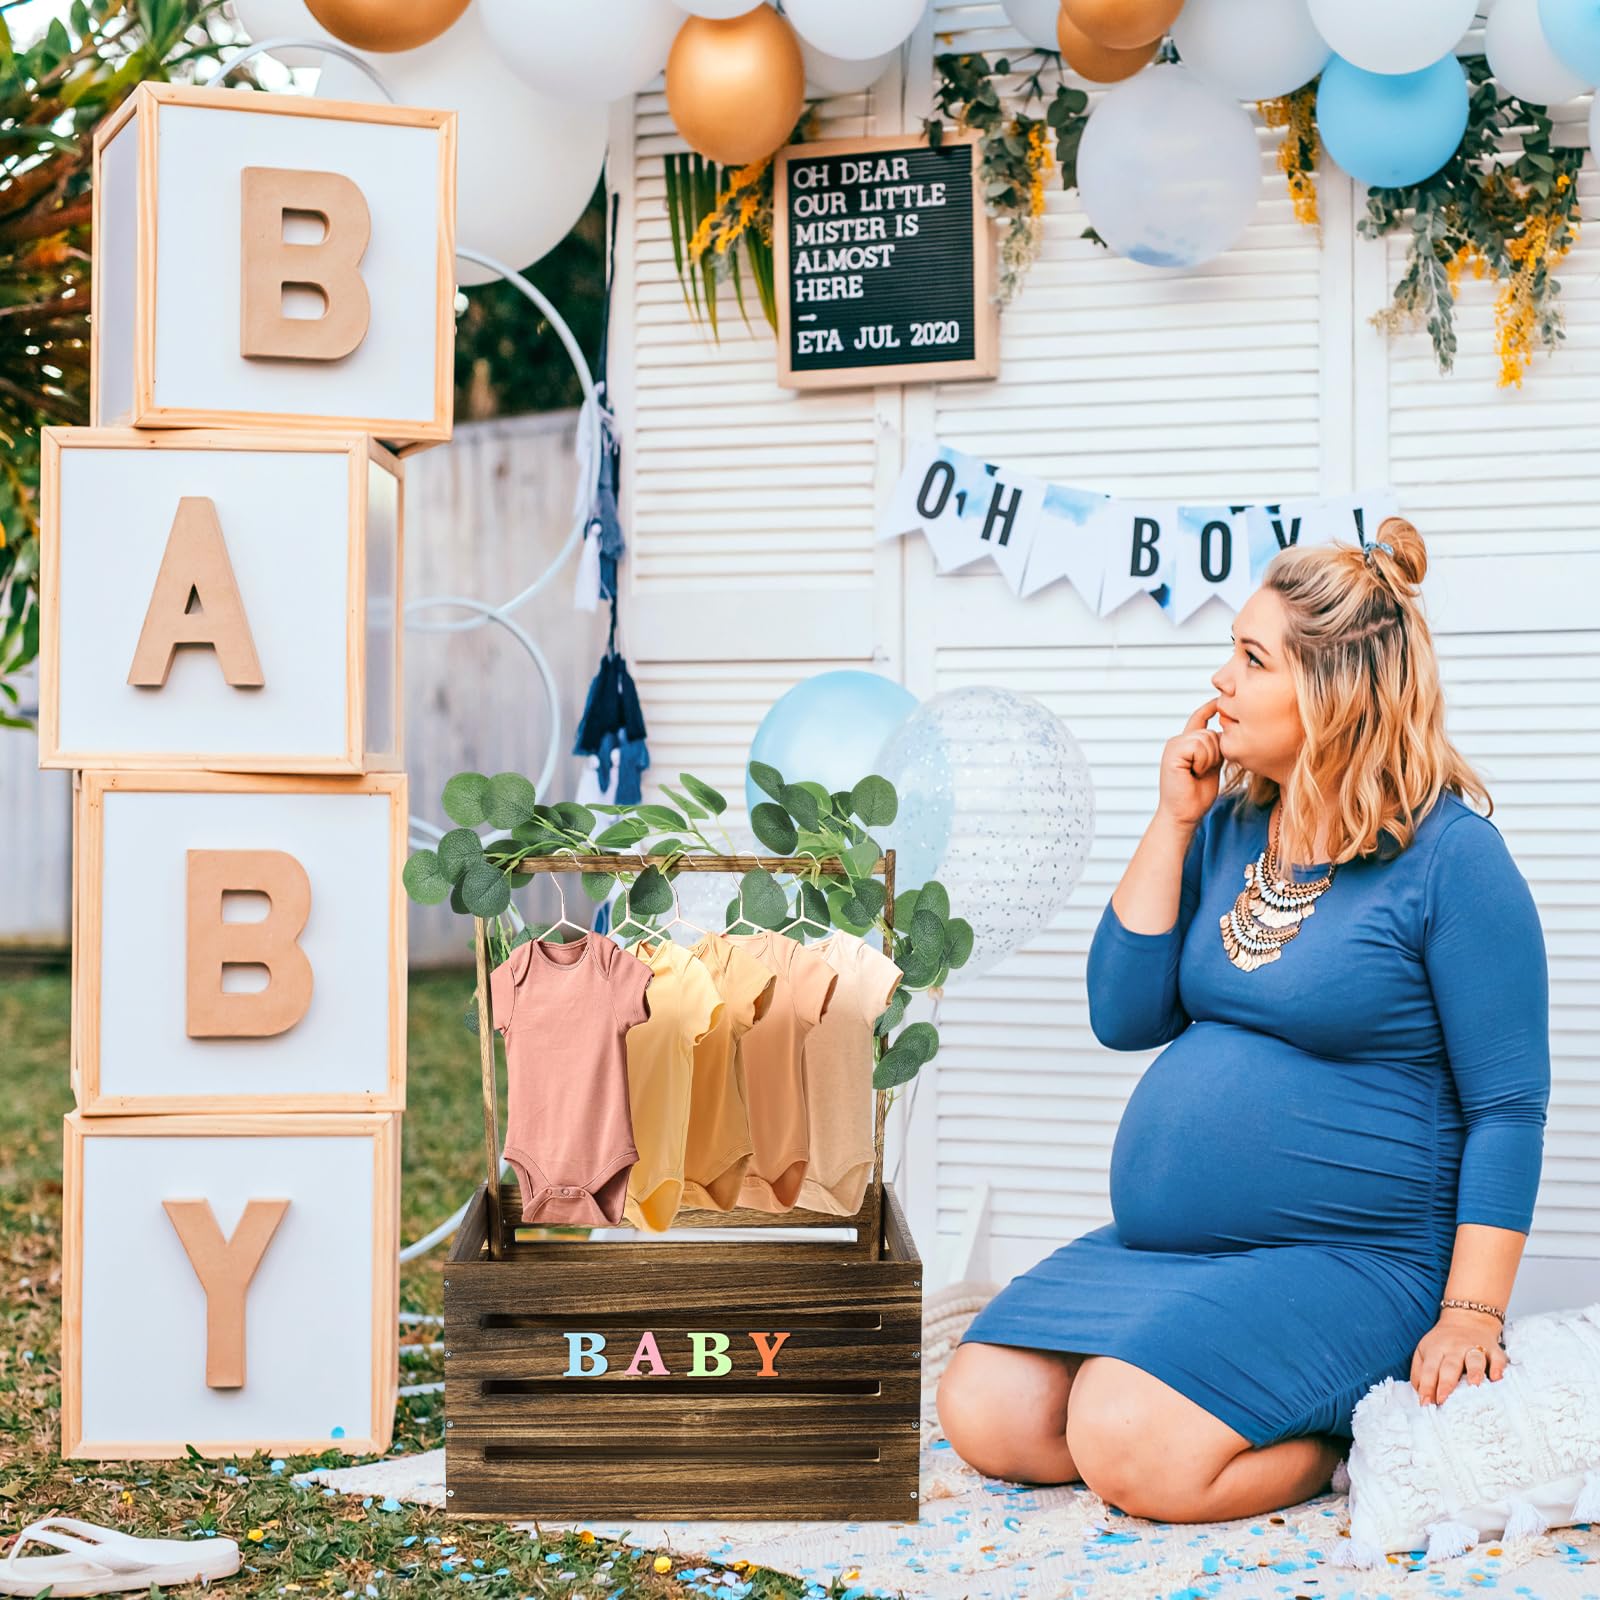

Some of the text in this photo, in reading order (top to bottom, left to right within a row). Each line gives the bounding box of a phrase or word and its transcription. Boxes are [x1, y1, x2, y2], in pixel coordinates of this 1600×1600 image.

[794, 158, 909, 188] OH DEAR
[794, 183, 946, 217] OUR LITTLE
[795, 214, 919, 246] MISTER IS
[794, 244, 895, 274] ALMOST
[796, 275, 863, 302] HERE
[798, 321, 959, 354] ETA JUL 2020
[916, 460, 1023, 547] OH
[563, 1331, 790, 1377] BABY
